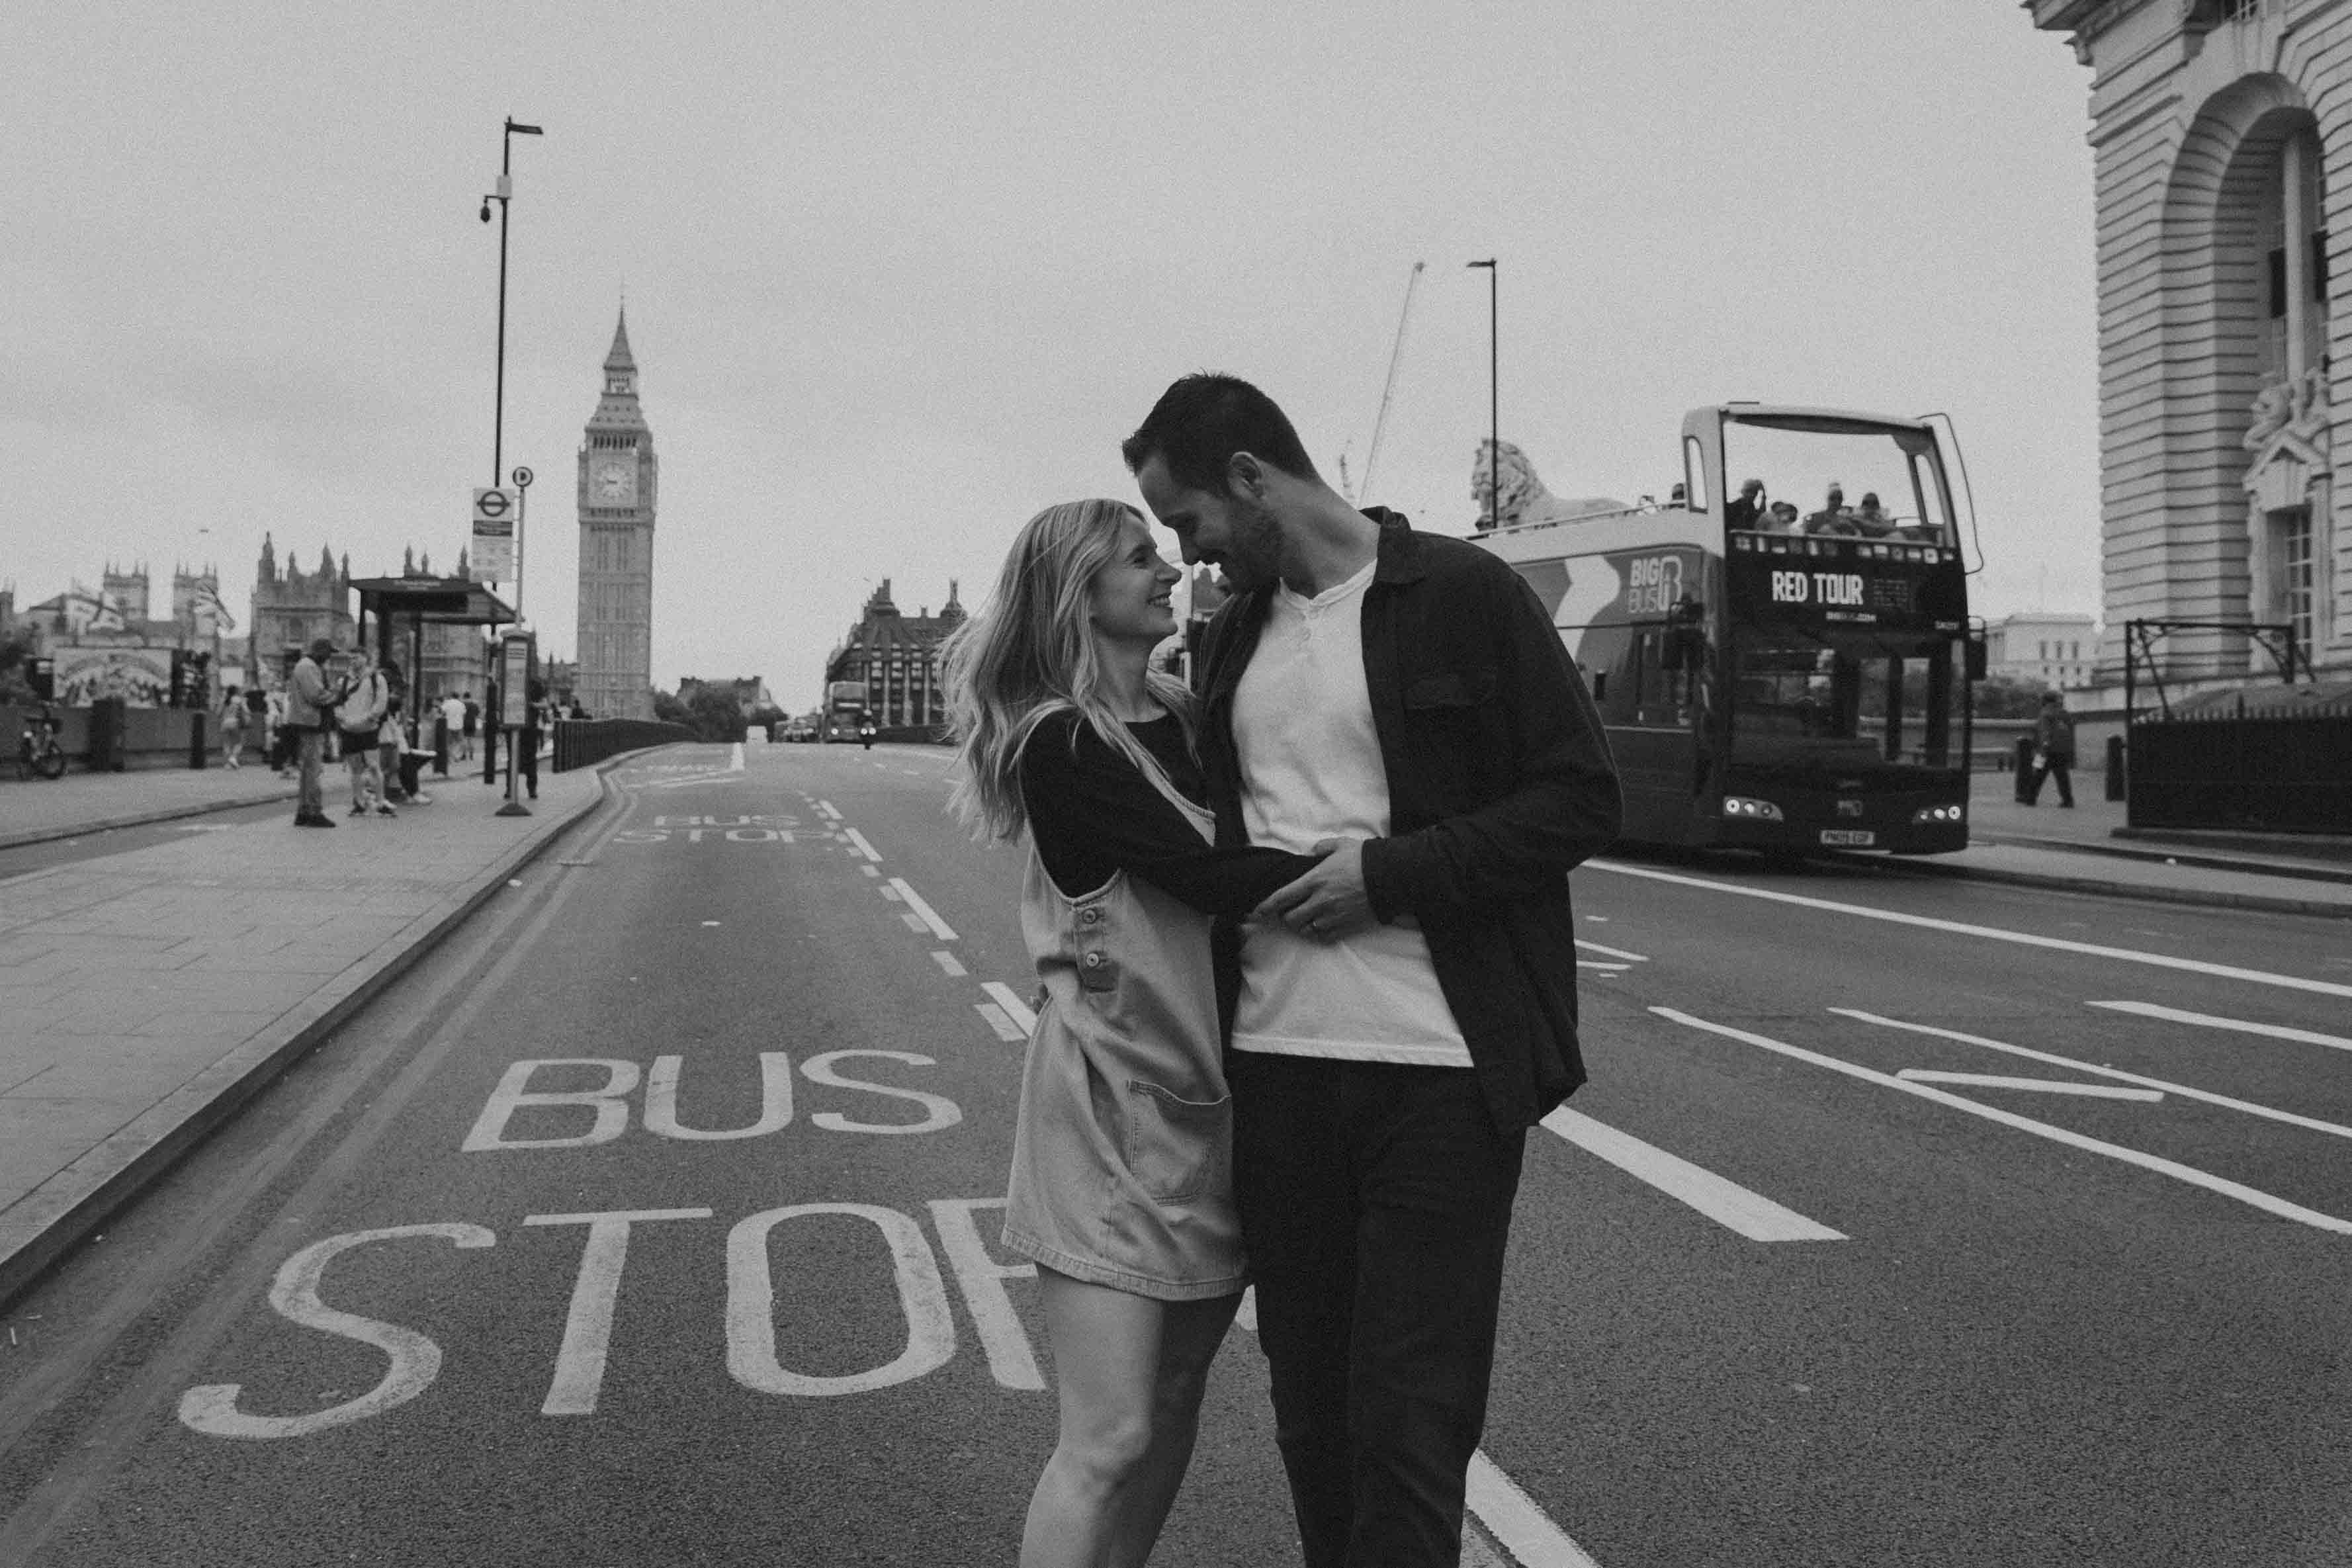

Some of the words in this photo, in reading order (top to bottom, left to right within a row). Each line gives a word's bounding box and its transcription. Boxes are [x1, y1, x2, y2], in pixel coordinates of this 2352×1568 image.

[1630, 558, 1659, 587] BIG
[1772, 570, 1808, 603] RED
[1813, 572, 1864, 605] TOUR
[1628, 588, 1657, 613] BUS
[462, 1049, 963, 1153] BUS
